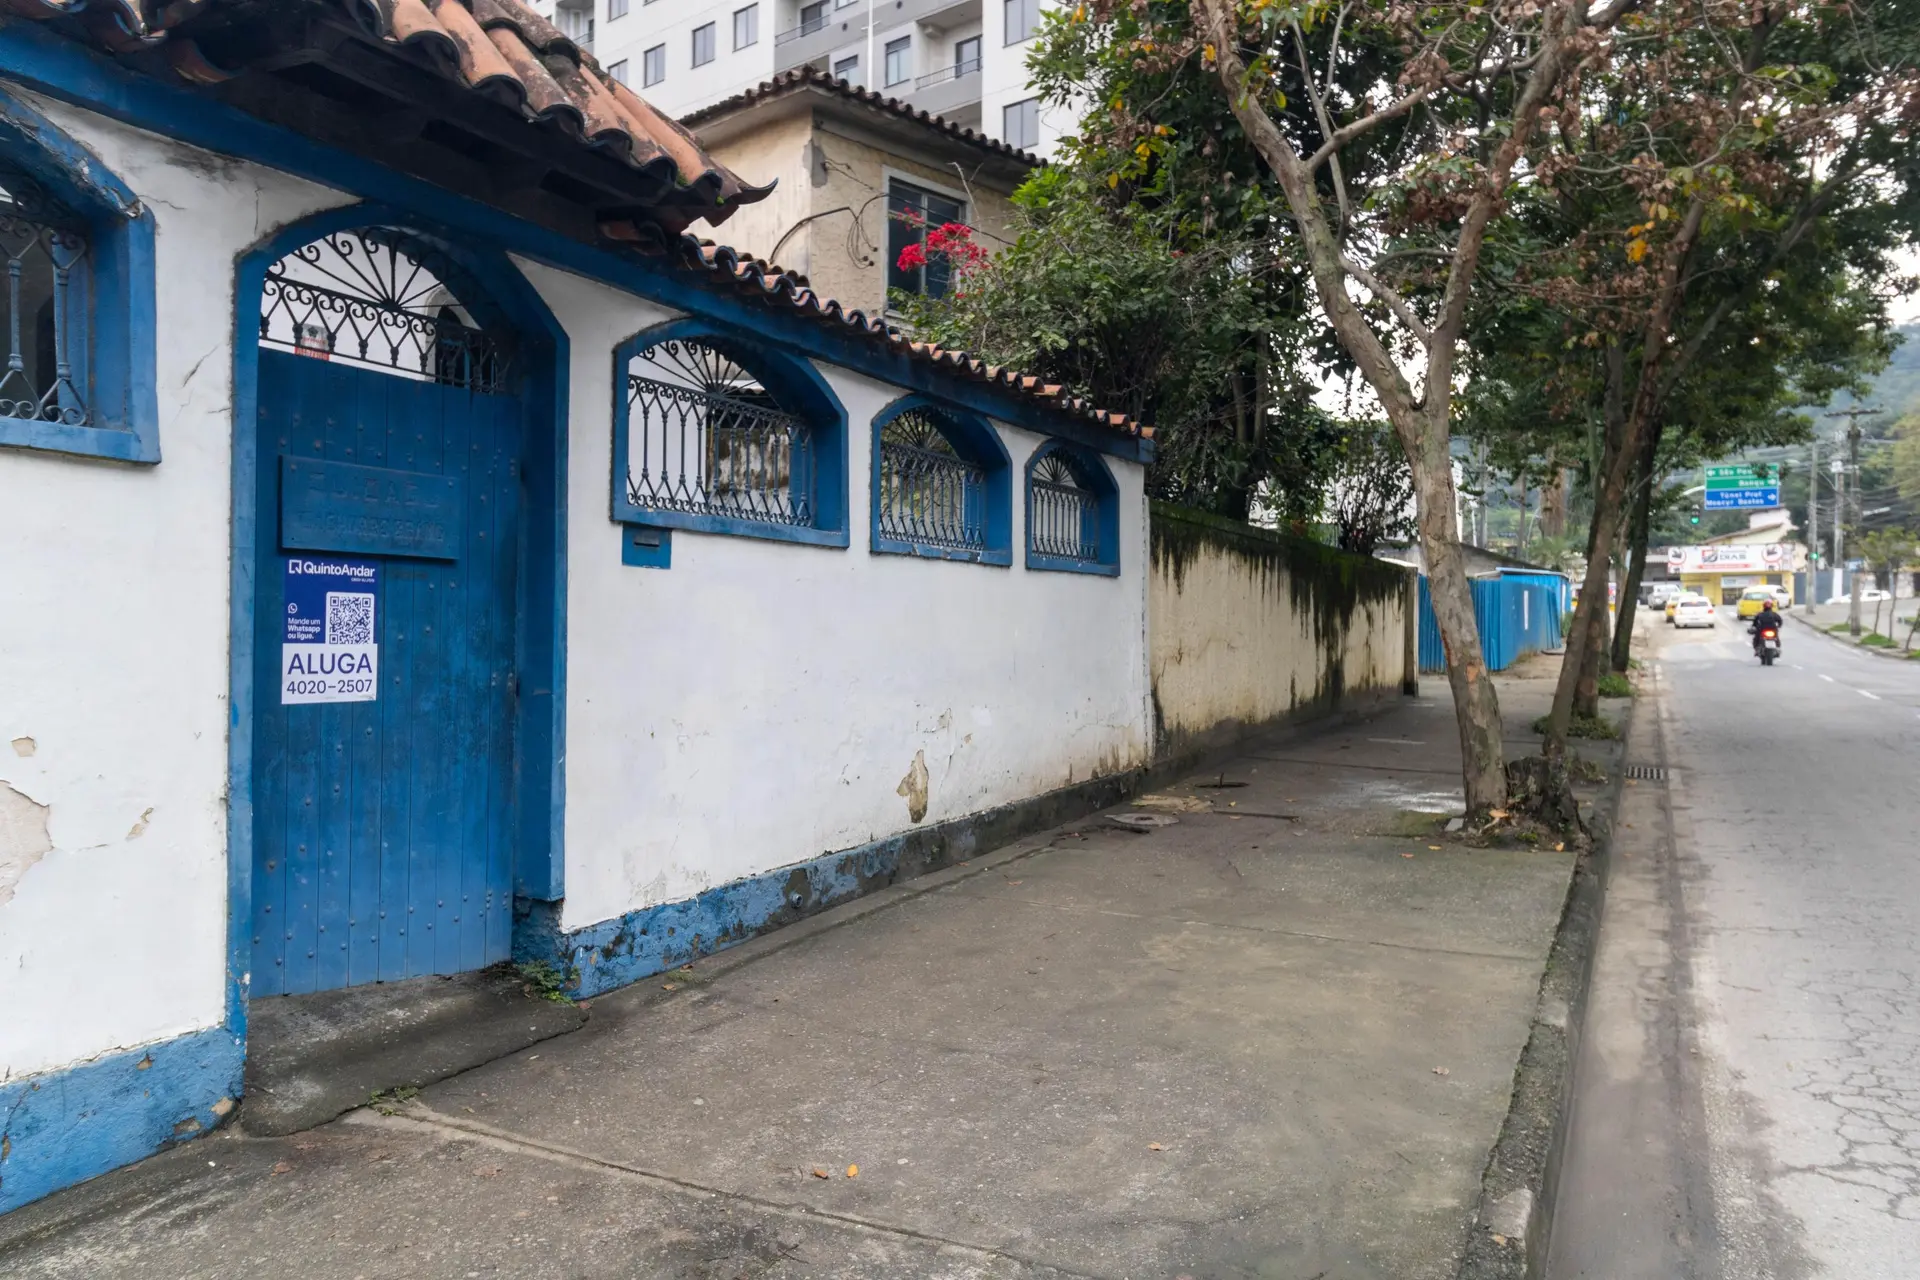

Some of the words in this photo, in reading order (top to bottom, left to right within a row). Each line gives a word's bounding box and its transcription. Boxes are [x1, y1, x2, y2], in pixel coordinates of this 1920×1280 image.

[303, 561, 375, 577] QuintoAndar
[288, 617, 308, 625] Mande
[288, 625, 320, 633] Whatsapp
[297, 632, 314, 640] ligue.
[287, 653, 372, 674] ALUGA
[287, 679, 372, 694] 4020-2507
